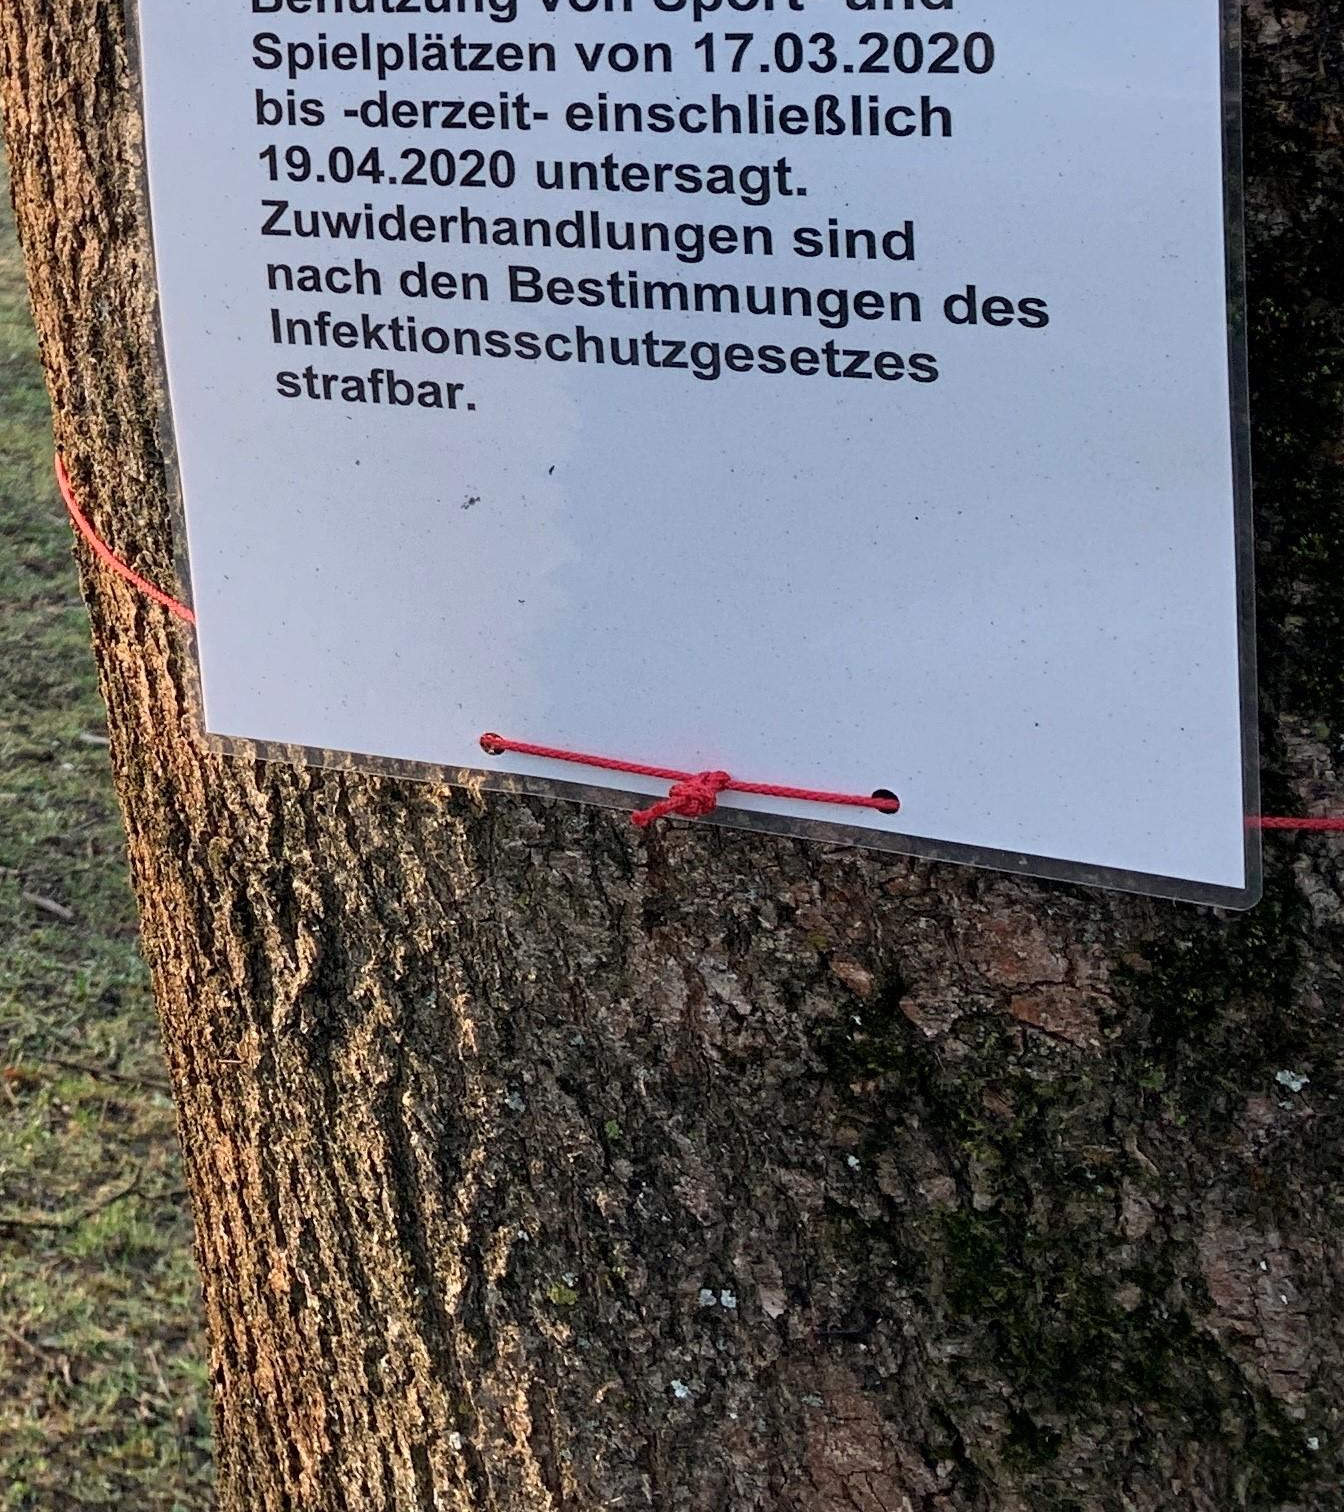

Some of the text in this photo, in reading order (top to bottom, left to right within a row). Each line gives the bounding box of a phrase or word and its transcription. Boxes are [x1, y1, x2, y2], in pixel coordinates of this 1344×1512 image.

[252, 31, 995, 81] Spielplätzen von 17.03.2020
[255, 88, 952, 138] bis -derzeit- einschließlich
[259, 144, 807, 207] 19.04.2020 untersagt.
[261, 199, 915, 264] Zuwiderhandlungen sind
[266, 258, 1050, 329] nach den Bestimmungen des
[270, 308, 939, 383] Infektionsschutzgesetzes
[276, 364, 476, 411] strafbar.
